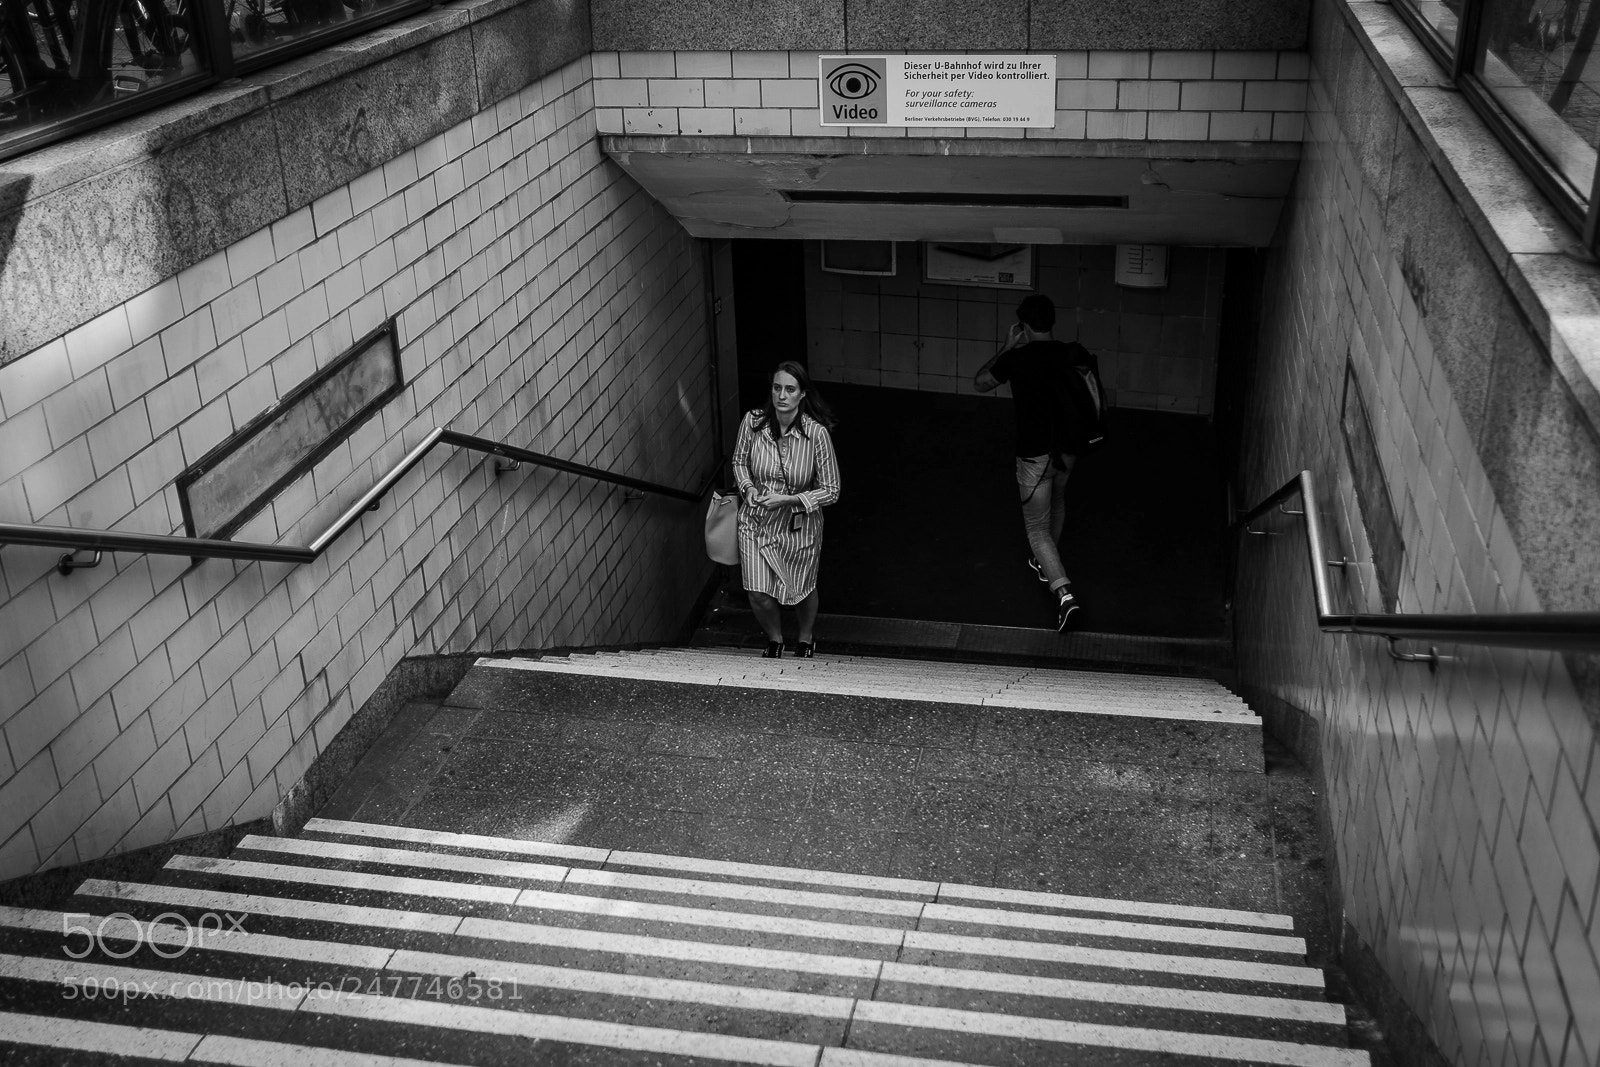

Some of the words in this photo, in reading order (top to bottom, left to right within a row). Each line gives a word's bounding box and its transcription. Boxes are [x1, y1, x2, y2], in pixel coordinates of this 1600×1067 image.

[904, 61, 932, 70] Dieser
[934, 61, 982, 70] U-Bahnhof
[984, 61, 1005, 70] wird
[1019, 61, 1042, 70] Ihrer
[904, 71, 949, 80] Sicherheit
[950, 73, 966, 82] per
[967, 71, 994, 80] Video
[996, 71, 1050, 80] kontrolliert.
[905, 89, 920, 98] For
[921, 91, 942, 99] your
[944, 89, 975, 99] safety:
[905, 99, 958, 108] surveillance
[832, 104, 878, 120] Video
